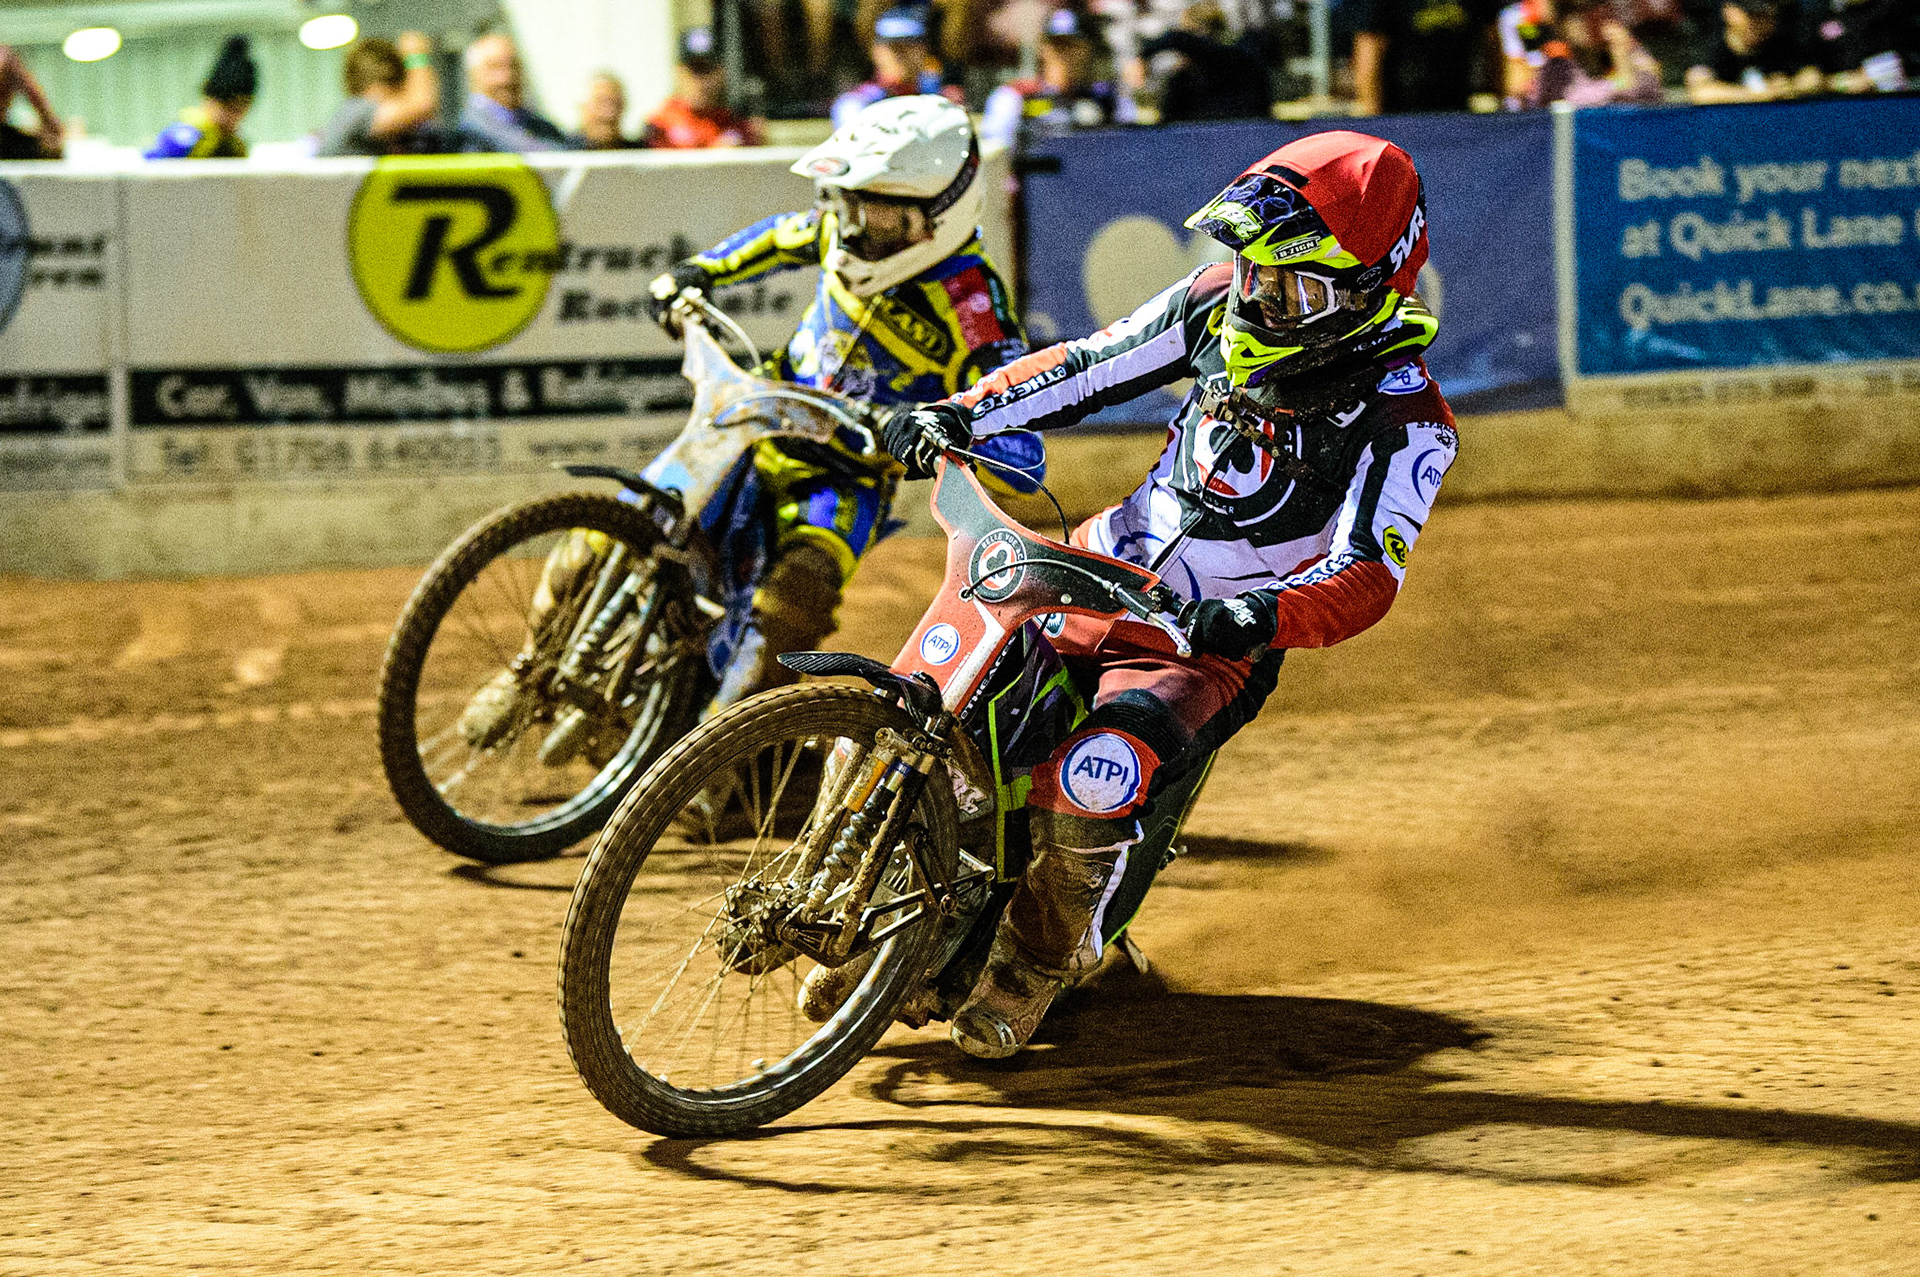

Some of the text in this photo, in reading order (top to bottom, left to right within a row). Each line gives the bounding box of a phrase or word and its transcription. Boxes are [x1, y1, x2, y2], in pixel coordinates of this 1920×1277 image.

[1619, 157, 1724, 200] Book
[1733, 160, 1828, 201] your
[1620, 218, 1660, 257] at
[1669, 210, 1792, 261] Quick
[1802, 208, 1904, 249] Lane
[502, 366, 531, 410] &
[927, 634, 953, 655] ATPI
[1073, 754, 1130, 787] ATPI
